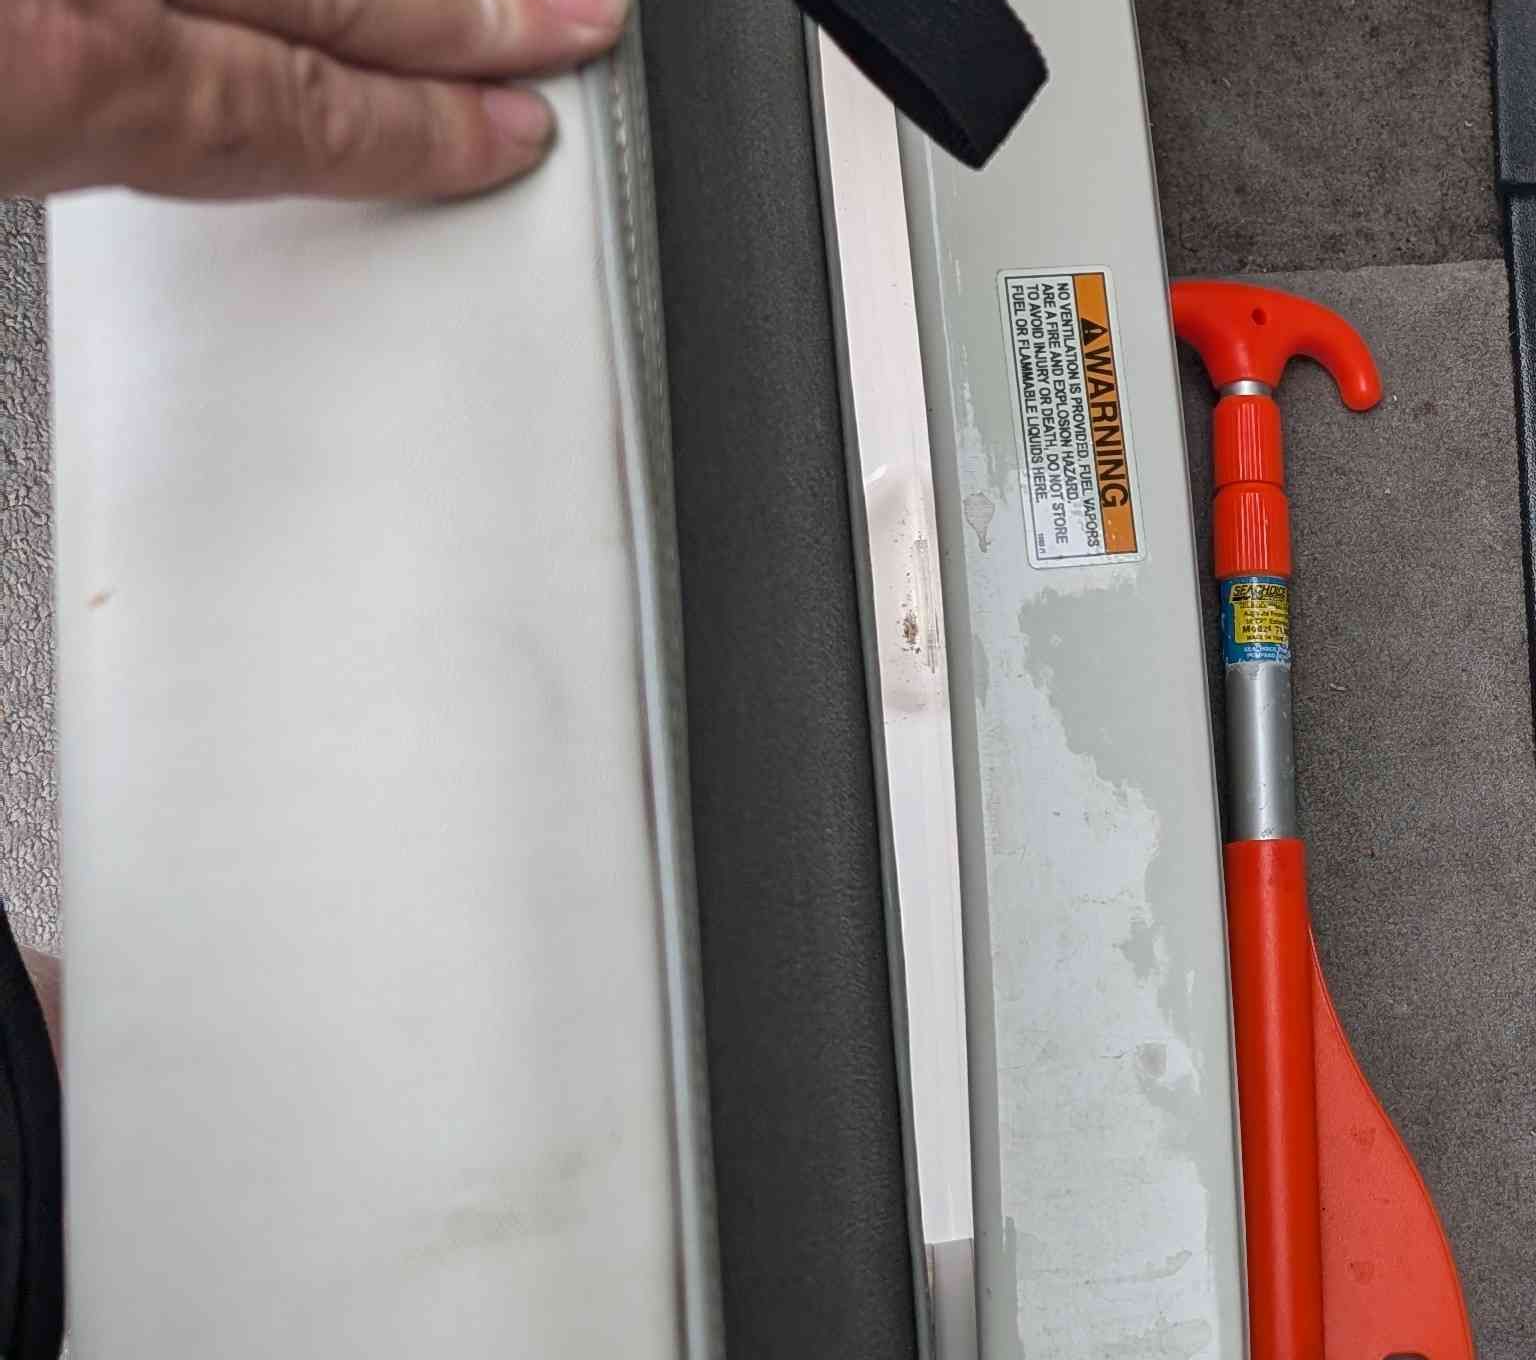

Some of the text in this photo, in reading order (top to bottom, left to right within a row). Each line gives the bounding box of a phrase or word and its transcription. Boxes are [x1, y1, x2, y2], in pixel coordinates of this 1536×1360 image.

[1058, 283, 1070, 300] NO
[1060, 303, 1080, 379] VENTILATION
[1012, 285, 1047, 503] FUEL OR FLAMMABLE LIQUIDS HERE.
[1027, 284, 1068, 544] TO AVOID INJURY OR DEATH, DO NOT STORE
[1042, 284, 1079, 503] ARE A FIRE AND EXPLOSION HAZARD.
[1070, 383, 1081, 394] IS
[1085, 345, 1128, 507] WARNING
[1079, 465, 1093, 496] FUEL
[1084, 498, 1099, 547] VAPORS
